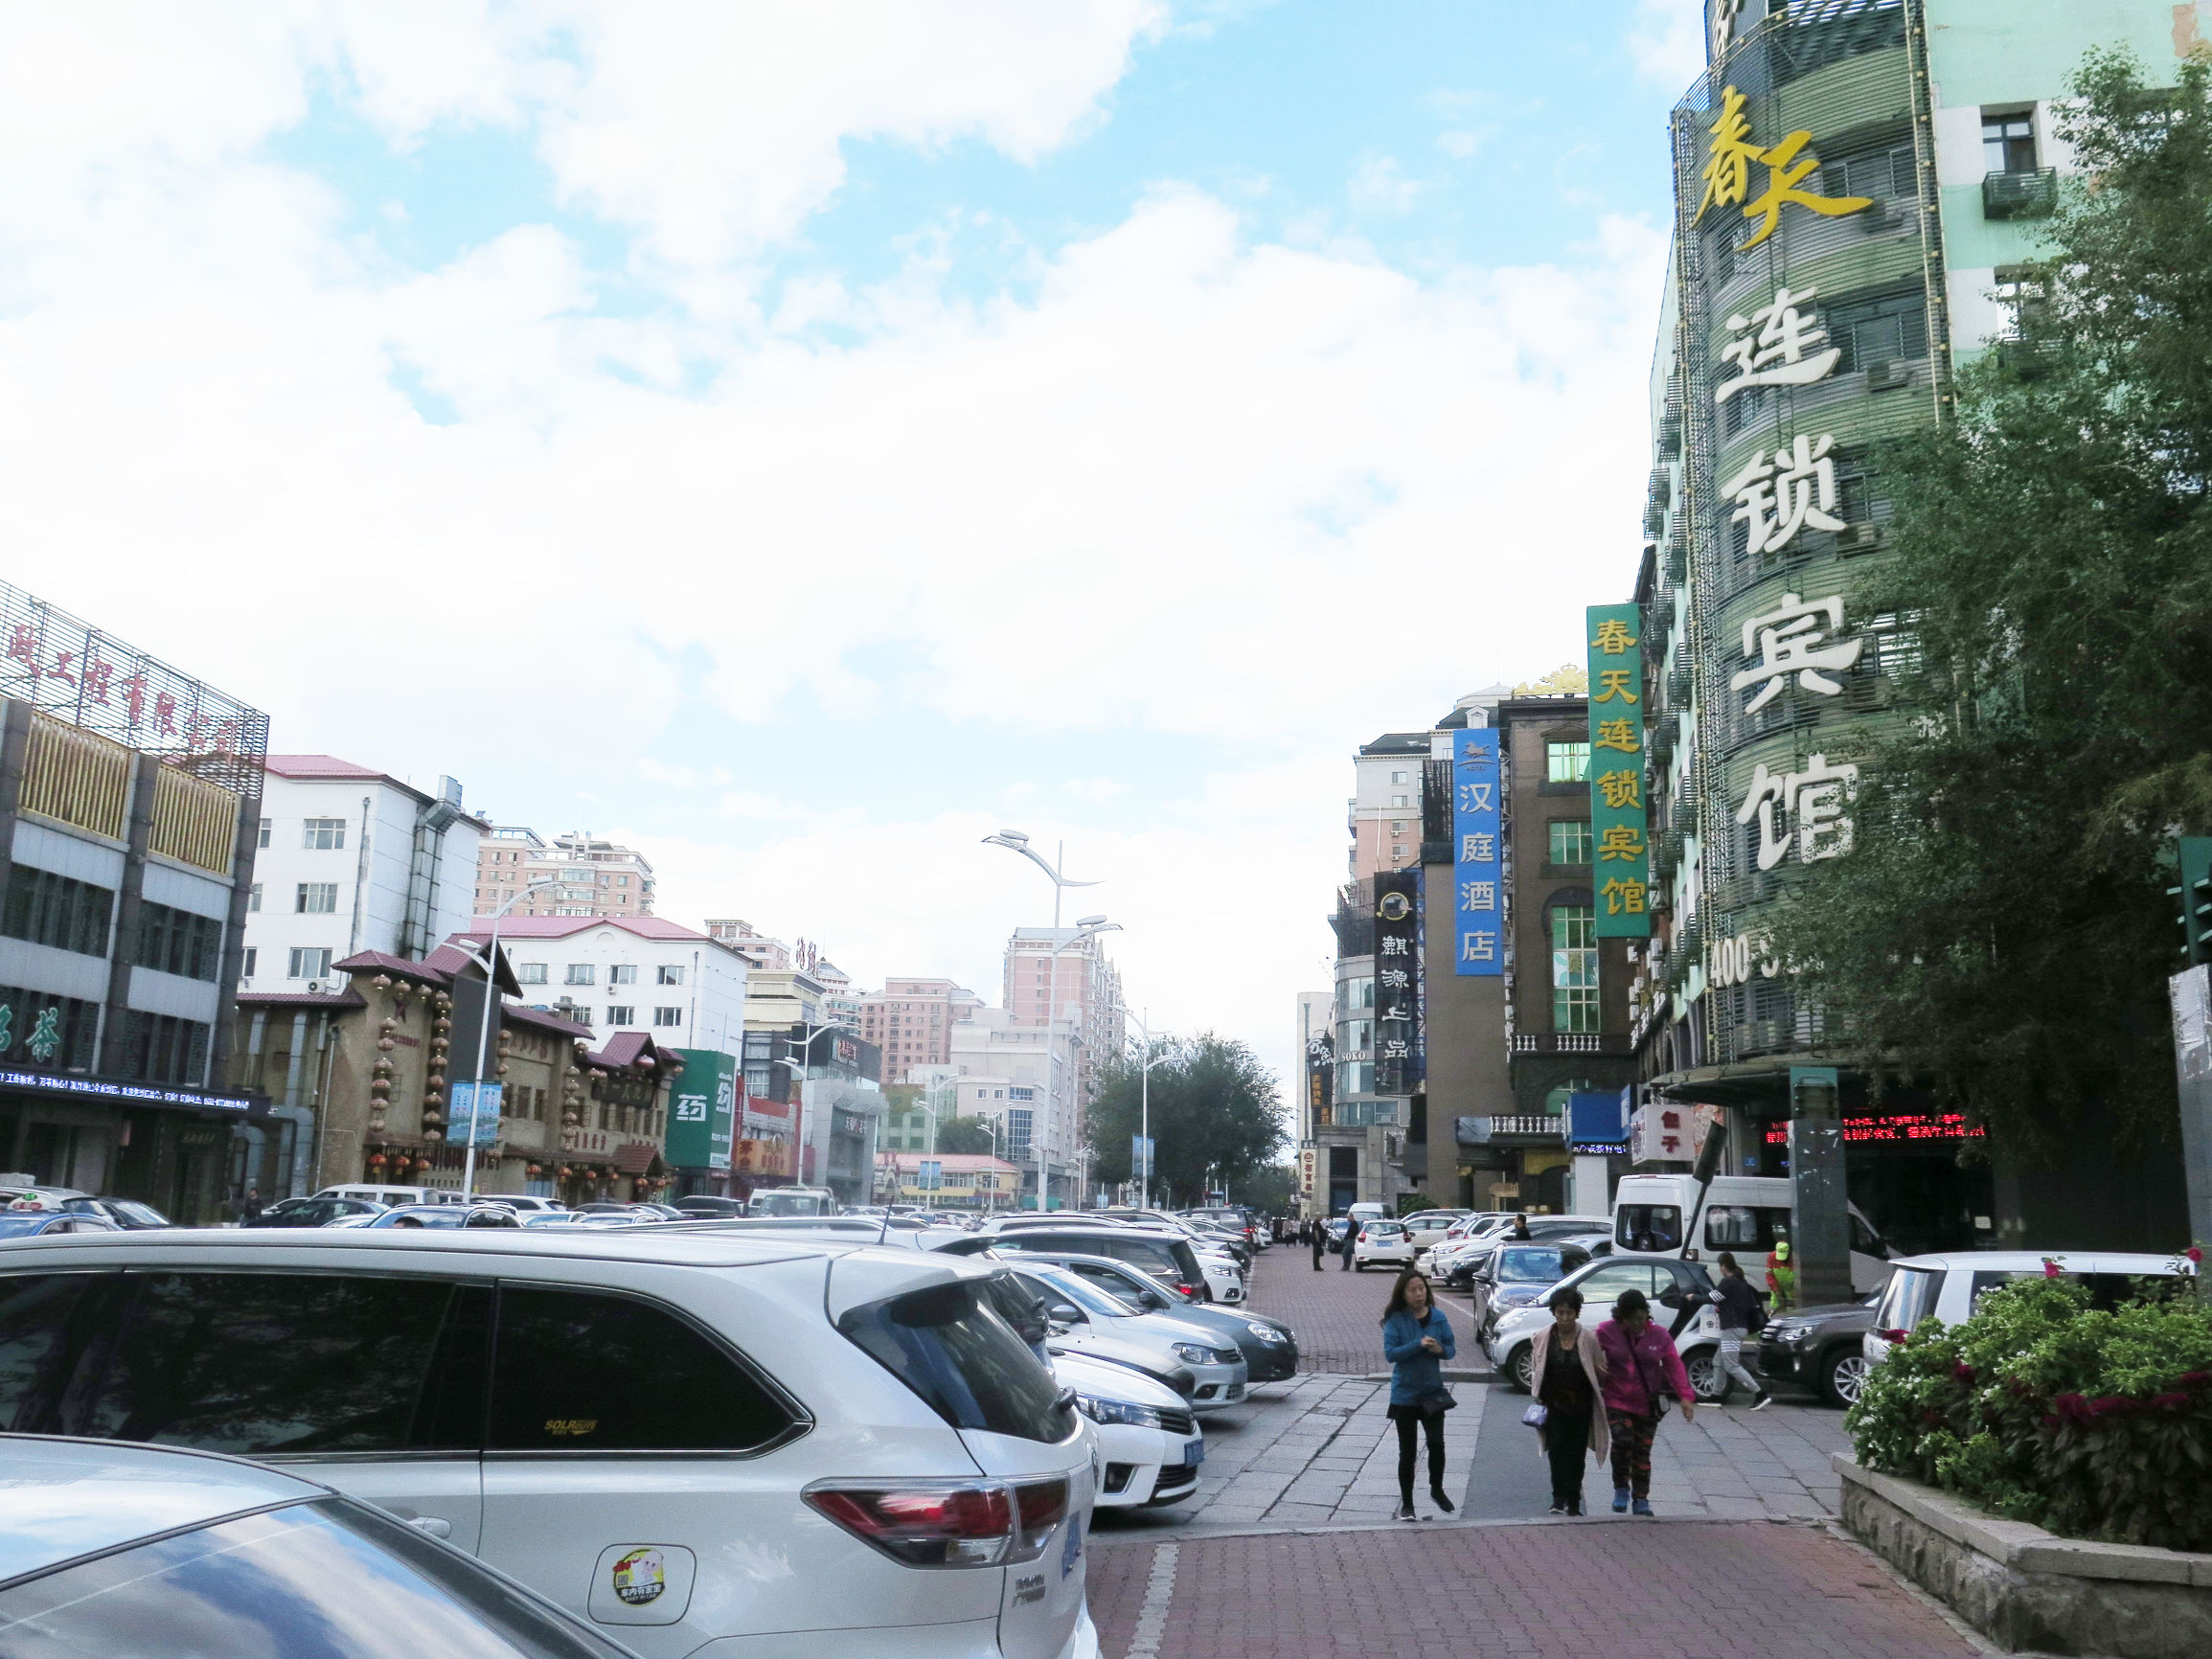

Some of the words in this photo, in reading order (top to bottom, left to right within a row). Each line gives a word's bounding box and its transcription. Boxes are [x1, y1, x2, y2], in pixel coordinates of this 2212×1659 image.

[1691, 85, 1874, 253] 春天
[1715, 287, 1863, 872] 连锁宾馆
[1591, 619, 1645, 915] 春天连锁宾馆
[1459, 783, 1495, 963] 汉庭酒店
[676, 1094, 707, 1121] 药
[621, 1583, 662, 1598] 车内有宝宝
